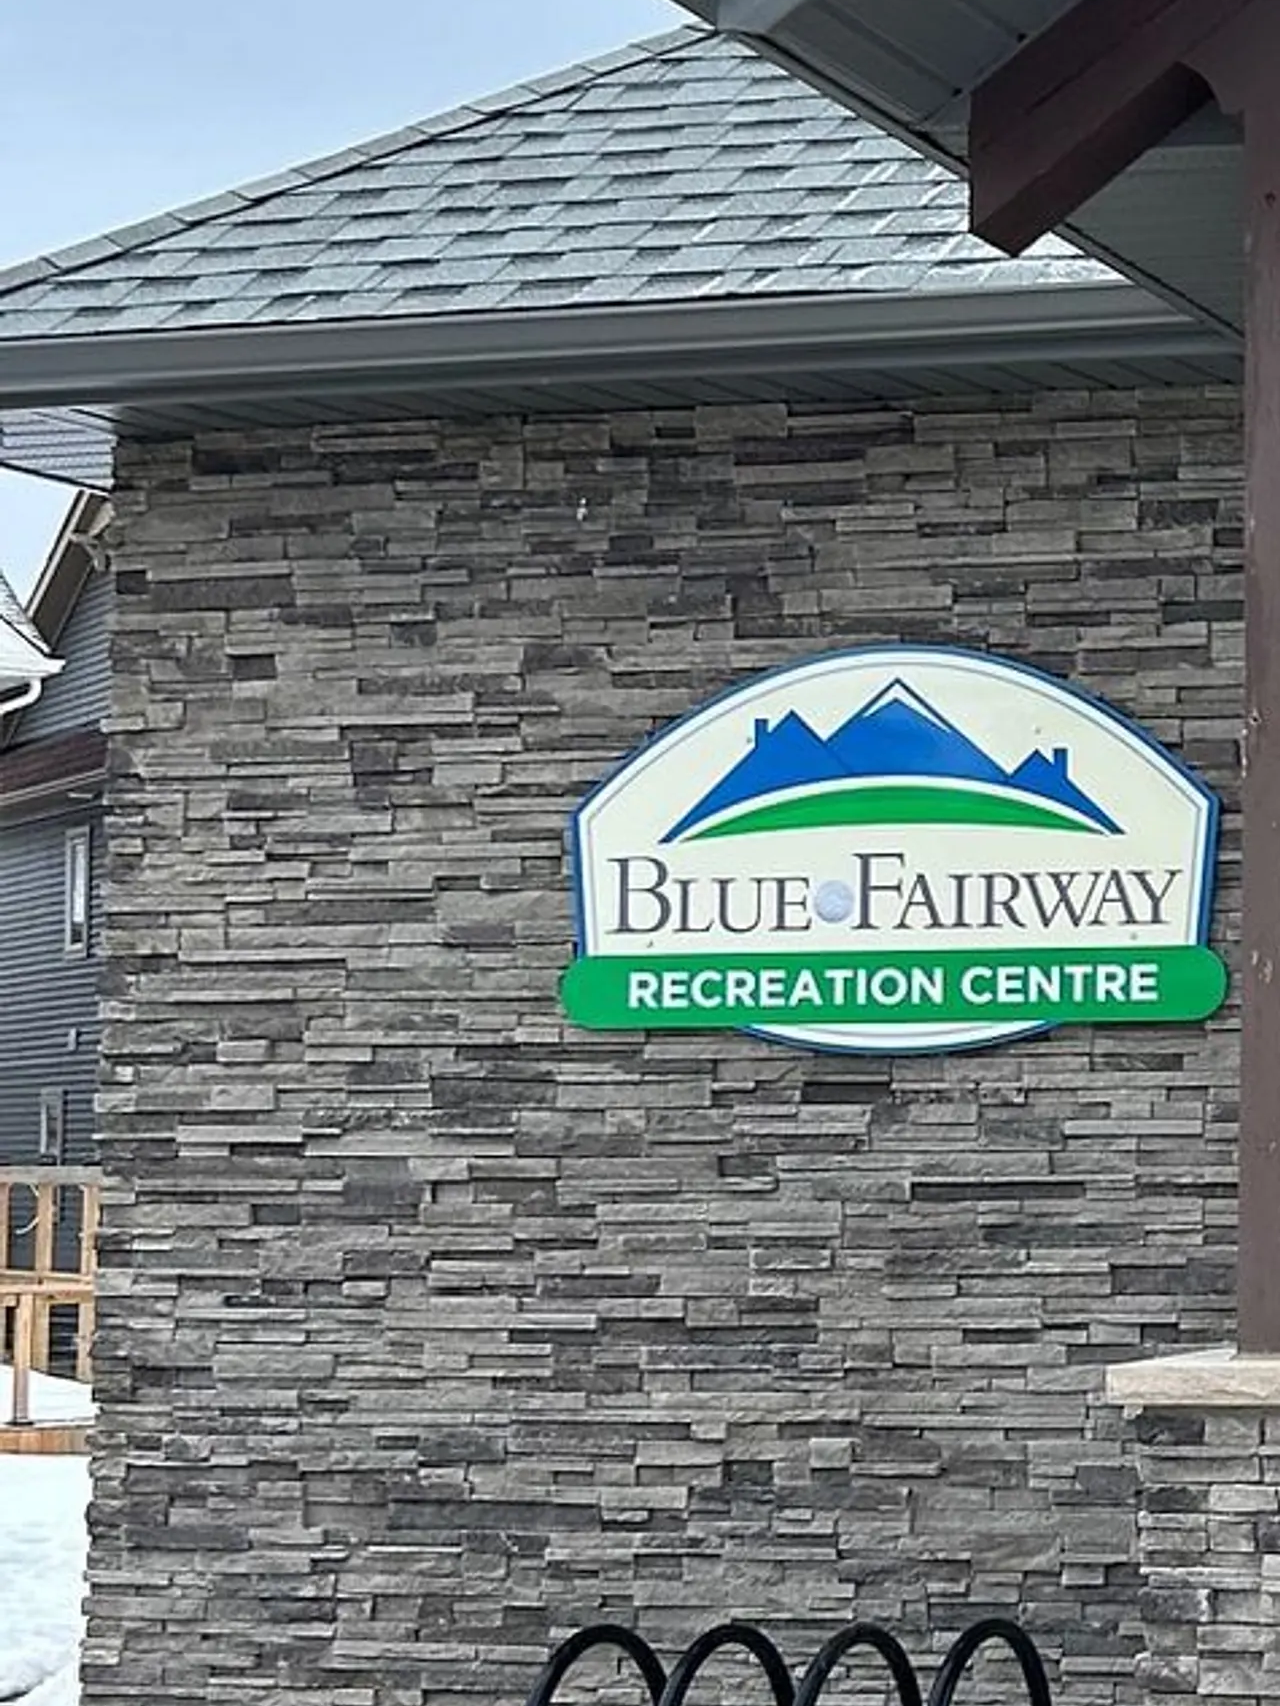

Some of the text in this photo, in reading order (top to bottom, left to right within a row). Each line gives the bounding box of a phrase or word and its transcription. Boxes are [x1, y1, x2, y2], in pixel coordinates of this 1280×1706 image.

[607, 852, 1183, 934] BLUE FAIRWAY
[628, 963, 1159, 1008] RECREATION CENTRE
